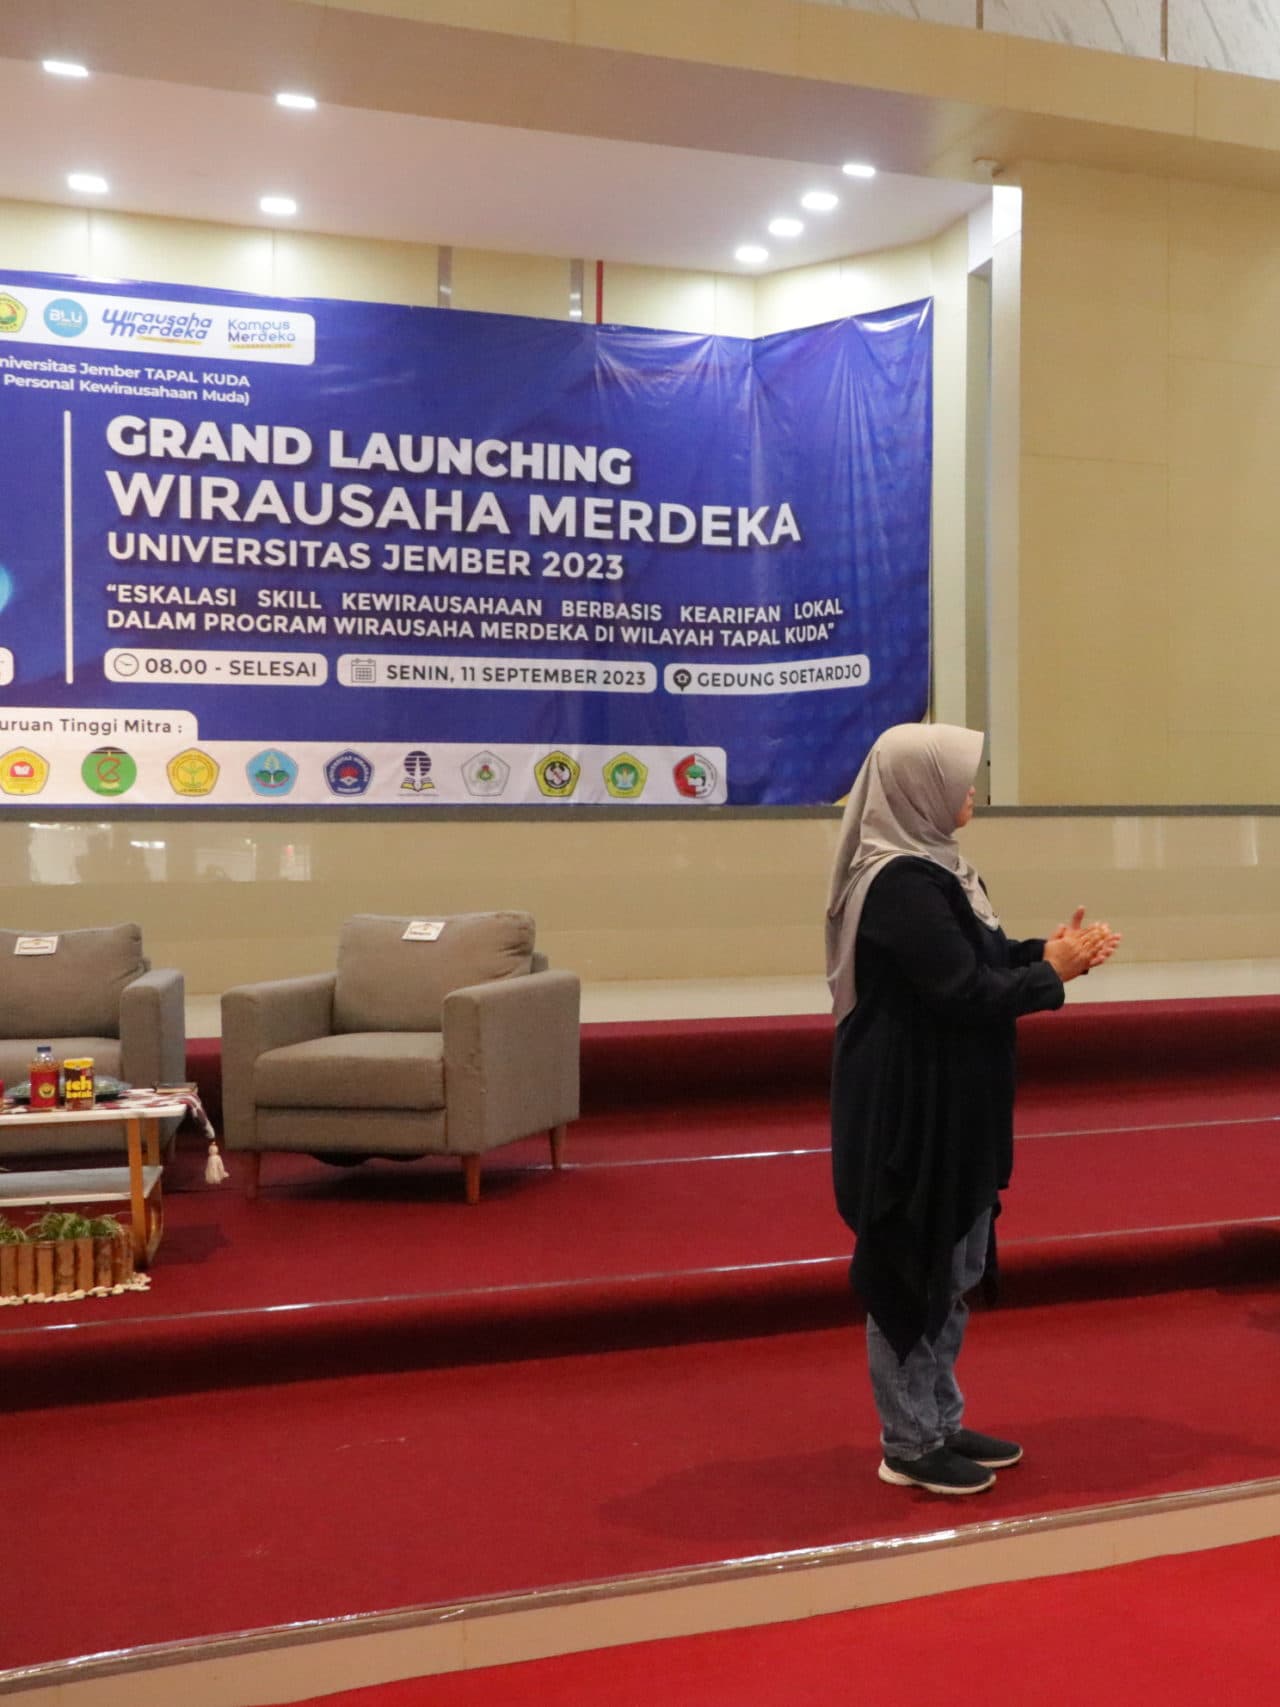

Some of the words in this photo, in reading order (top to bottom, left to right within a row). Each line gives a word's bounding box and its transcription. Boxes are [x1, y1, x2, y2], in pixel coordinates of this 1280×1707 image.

[50, 308, 83, 323] BLU
[227, 319, 291, 333] Kampus
[227, 330, 296, 342] Merdeka
[80, 363, 141, 379] Jember
[144, 367, 199, 384] TAPAL
[203, 372, 250, 387] KUDA
[4, 374, 74, 391] Personal
[80, 381, 198, 400] Kewirausahaan
[202, 390, 250, 406] Muda)
[106, 415, 313, 465] GRAND
[329, 430, 632, 485] LAUNCHING
[105, 471, 510, 533] WIRAUSAHA
[529, 494, 801, 547] MERDEKA
[108, 532, 371, 569] UNIVERSITAS
[383, 544, 530, 576] JEMBER
[542, 551, 624, 580] 2023
[257, 589, 322, 609] SKILL
[342, 593, 542, 616] KEWIRAUSAHAAN
[561, 600, 662, 621] BERBASIS
[681, 605, 781, 623] KEARIFAN
[794, 598, 843, 620] LOKAL
[107, 610, 196, 630] DALAM
[204, 613, 327, 634] PROGRAM
[334, 617, 474, 638] WIRAUSAHA
[480, 621, 589, 641] MERDEKA
[595, 625, 614, 643] DI
[621, 627, 714, 646] WILAYAH
[720, 629, 780, 647] TAPAL
[145, 658, 207, 675] 08.00
[229, 660, 316, 677] SELESAI
[386, 664, 455, 683] SENIN,
[461, 667, 476, 682] 11
[483, 667, 597, 684] SEPTEMBER
[603, 670, 646, 685] 2023
[698, 672, 774, 687] GEDUNG
[779, 663, 862, 685] SOETARDJO
[60, 719, 118, 736] Tinggi
[124, 720, 172, 733] Mitra
